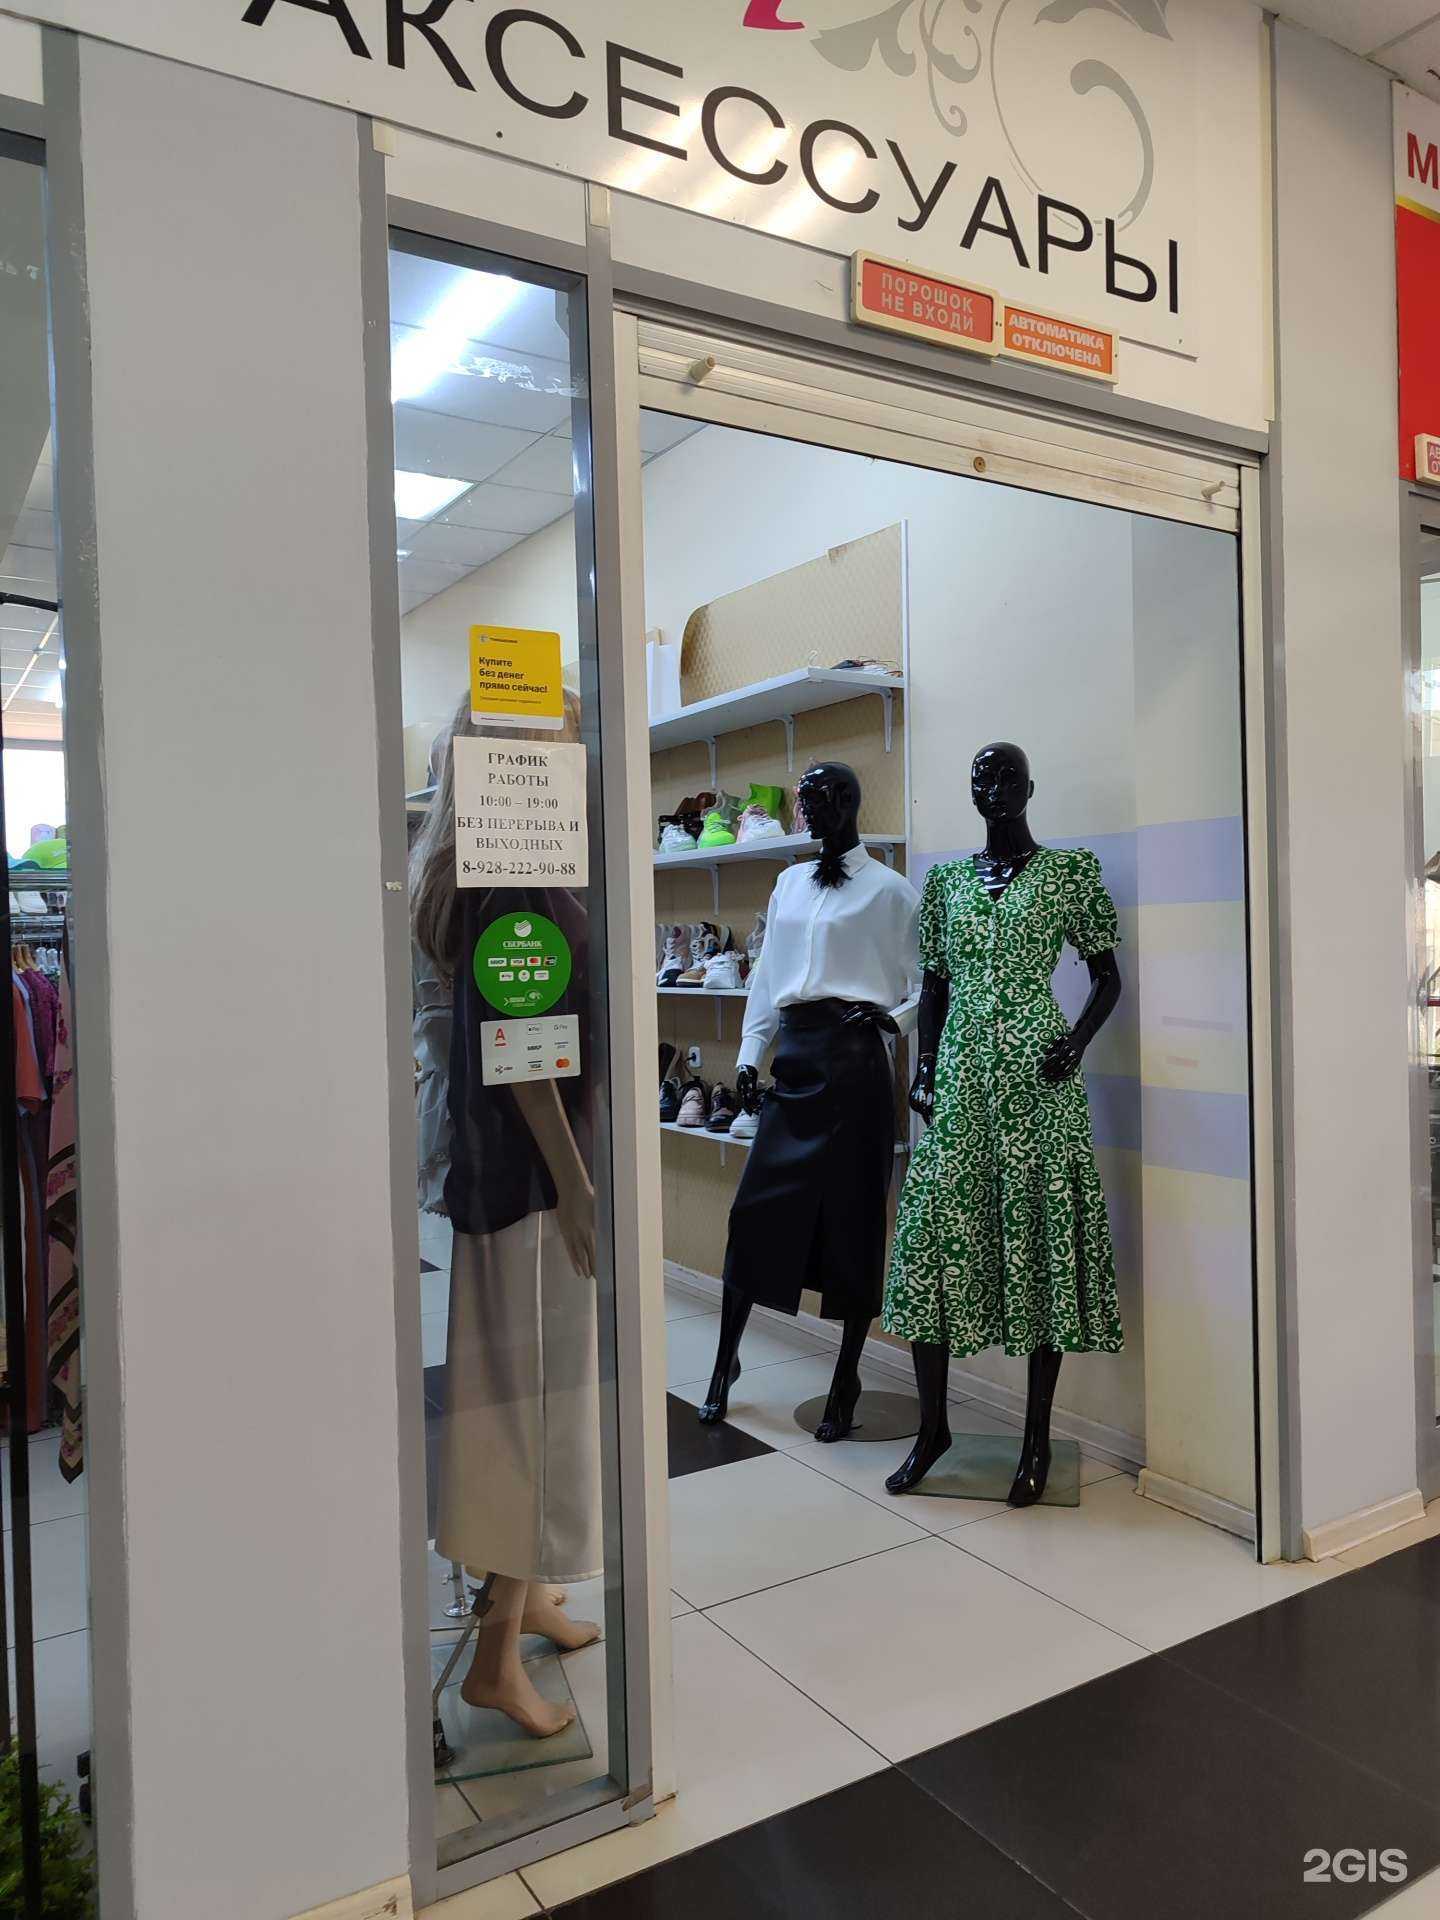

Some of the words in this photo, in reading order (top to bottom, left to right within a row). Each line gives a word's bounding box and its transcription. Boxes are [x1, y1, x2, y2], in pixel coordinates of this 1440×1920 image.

[881, 272, 973, 314] ПОРОШОК
[881, 292, 905, 313] НЕ
[912, 301, 974, 332] ВХОДИ
[1008, 313, 1105, 350] АВТОМАТИКА
[1011, 332, 1102, 367] ОТКЛЮЧЕНА
[479, 657, 512, 667] Купите
[479, 668, 496, 677] без
[497, 671, 524, 680] денег
[479, 681, 510, 690] прямо
[512, 684, 548, 693] сейчас!
[488, 753, 548, 767] ГРАФИК
[488, 773, 549, 787] РАБОТЫ
[480, 795, 512, 807] 10:00
[527, 797, 558, 809] 19:00
[457, 817, 483, 828] БЕЗ
[488, 818, 565, 831] ПЕРЕРЫВА
[569, 821, 579, 831] И
[476, 838, 563, 851] ВЫХОДНЫХ
[462, 860, 576, 875] 8-928-222-90-88
[503, 940, 542, 948] СБЕРБАНК
